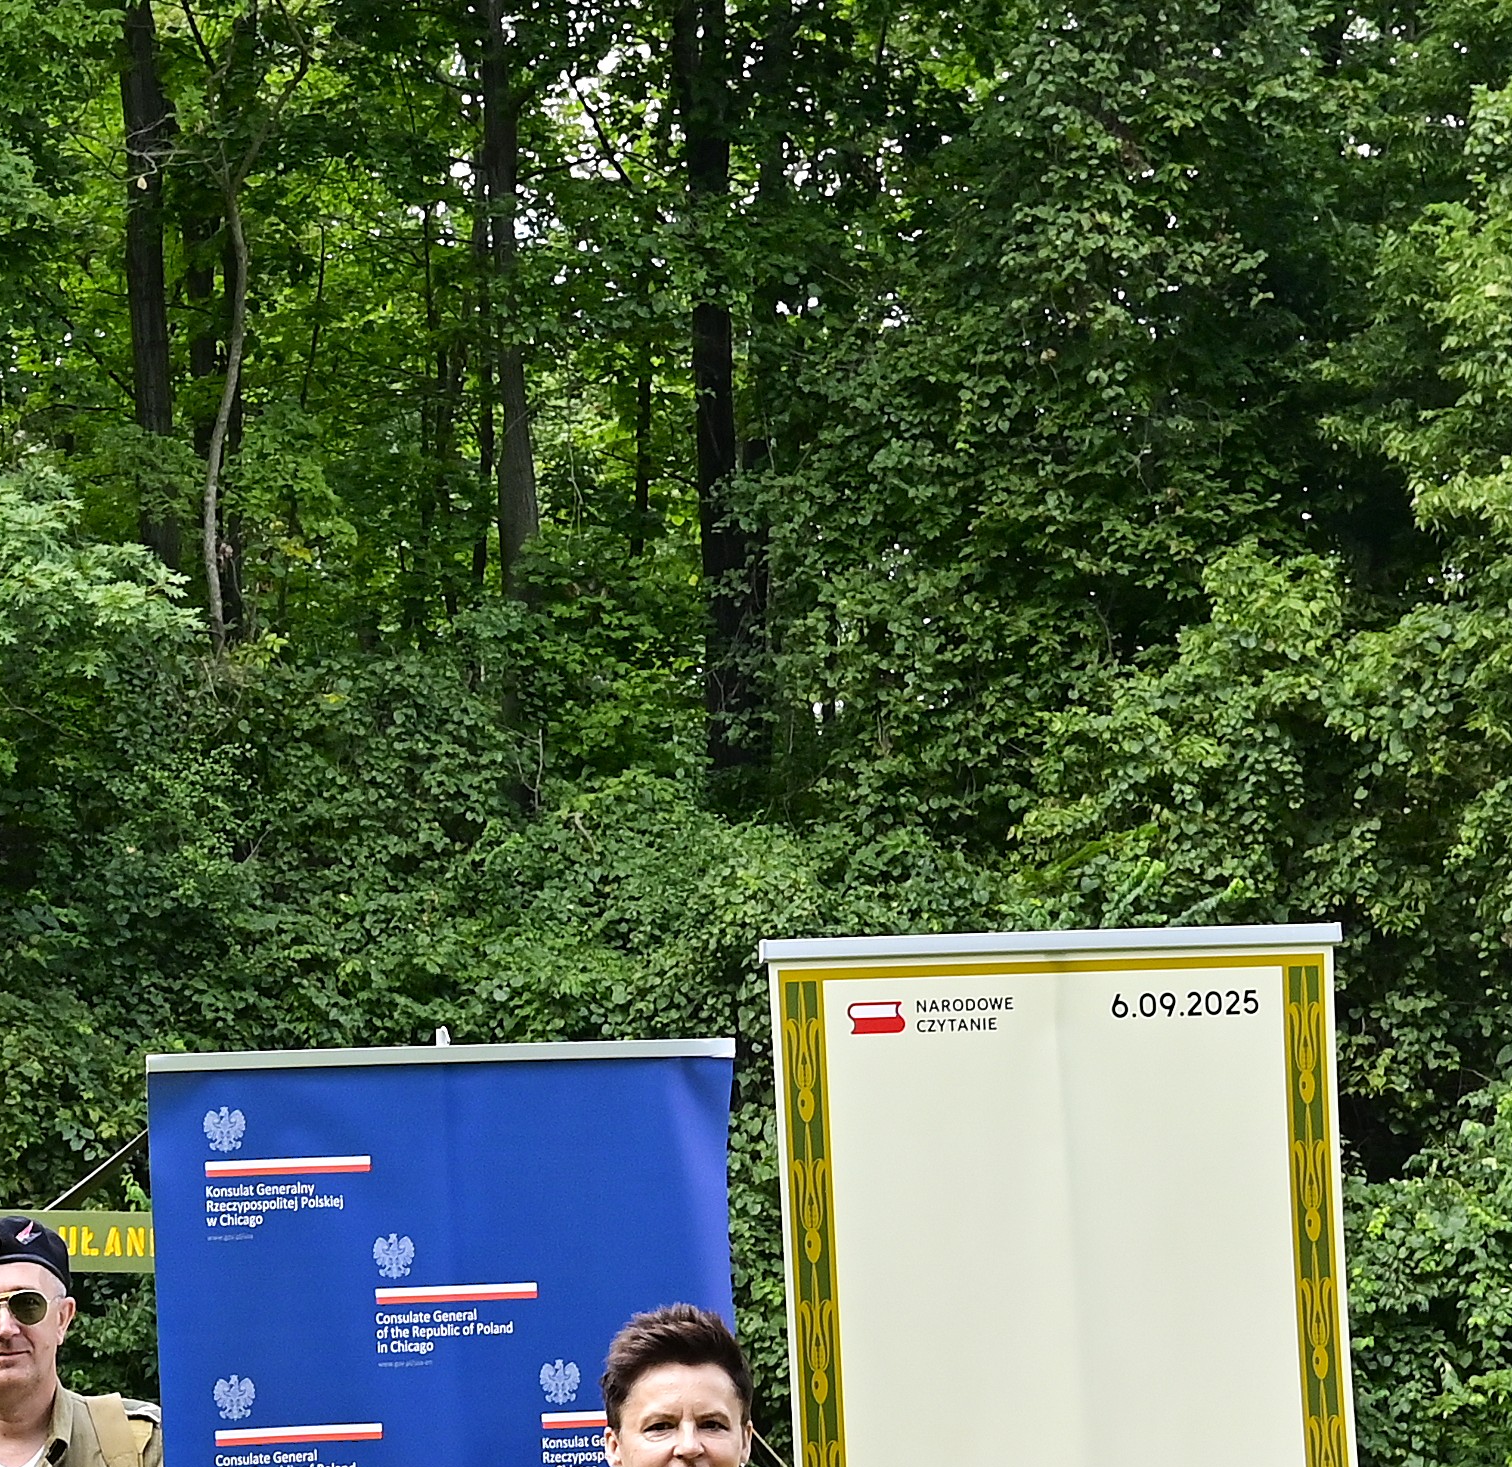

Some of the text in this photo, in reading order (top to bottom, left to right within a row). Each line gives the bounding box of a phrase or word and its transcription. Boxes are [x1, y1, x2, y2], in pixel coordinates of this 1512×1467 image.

[915, 996, 1014, 1014] NARODOWE
[1111, 989, 1259, 1019] 6.09.2025
[916, 1015, 998, 1033] CZYTANIE
[206, 1182, 315, 1198] Konsulat Generalny
[206, 1195, 344, 1214] Rzeczypospolitej Polskiej
[206, 1214, 263, 1228] w Chicago
[58, 1226, 154, 1257] UŁAN
[375, 1308, 477, 1325] Consulate General
[376, 1321, 513, 1340] of the Republic of Poland
[377, 1339, 434, 1355] in Chicago
[542, 1435, 589, 1450] Konsulat
[215, 1450, 318, 1467] Consulate General
